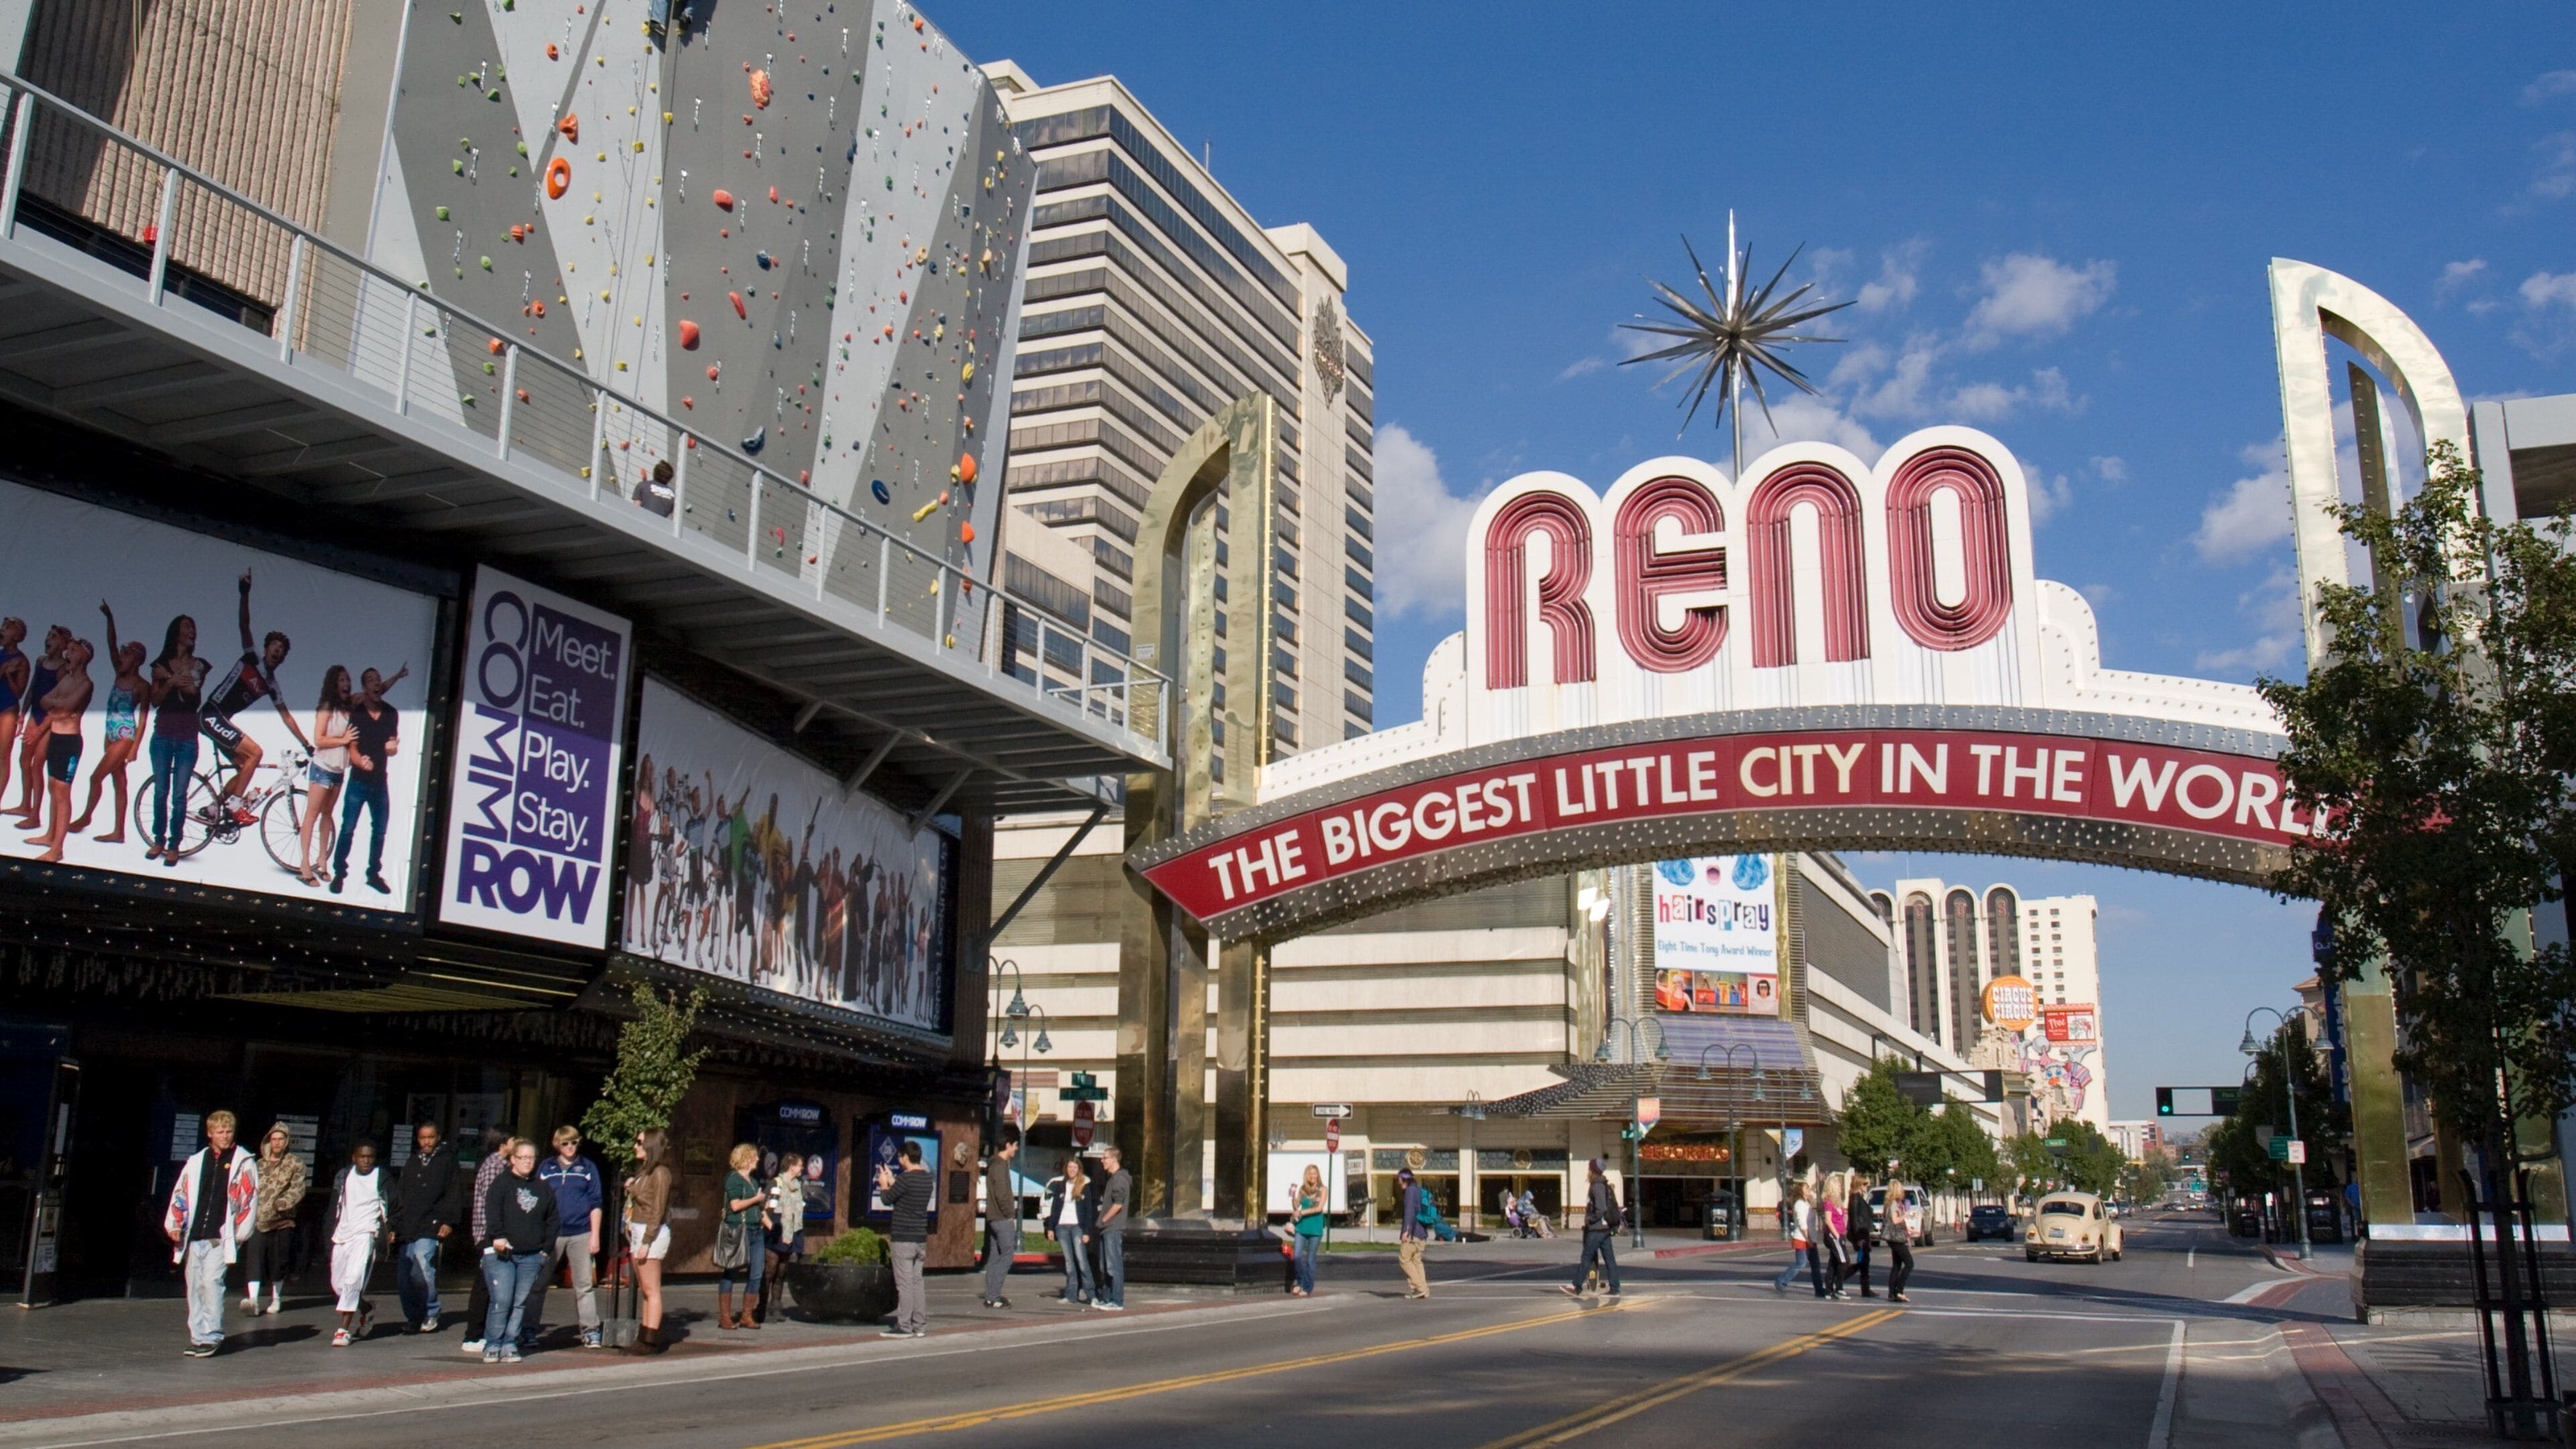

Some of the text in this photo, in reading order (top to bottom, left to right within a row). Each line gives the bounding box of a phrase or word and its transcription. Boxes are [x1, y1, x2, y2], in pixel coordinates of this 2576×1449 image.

[1485, 445, 2012, 690] RENO
[534, 616, 616, 680] Meet.
[205, 716, 237, 741] Audi
[462, 590, 529, 843] COMM
[528, 673, 586, 729] Eat.
[522, 729, 590, 793] Play.
[515, 791, 590, 852] Stay.
[1208, 828, 1307, 901] THE
[1320, 773, 1536, 866] BIGGEST
[1554, 750, 1718, 816] LITTLE
[1739, 743, 1866, 797] CITY
[1881, 743, 1948, 794] IN
[1970, 744, 2085, 803] THE
[456, 837, 602, 925] ROW
[933, 841, 948, 1028] Reno's Looking Up
[1658, 894, 1770, 932] hairspray
[1658, 939, 1772, 957] Eight Time Tony Award Winner
[1992, 986, 2034, 1004] CIRCUS
[1993, 1003, 2035, 1020] CIRCUS
[780, 1106, 820, 1120] COMMROW
[891, 1114, 928, 1129] COMMROW
